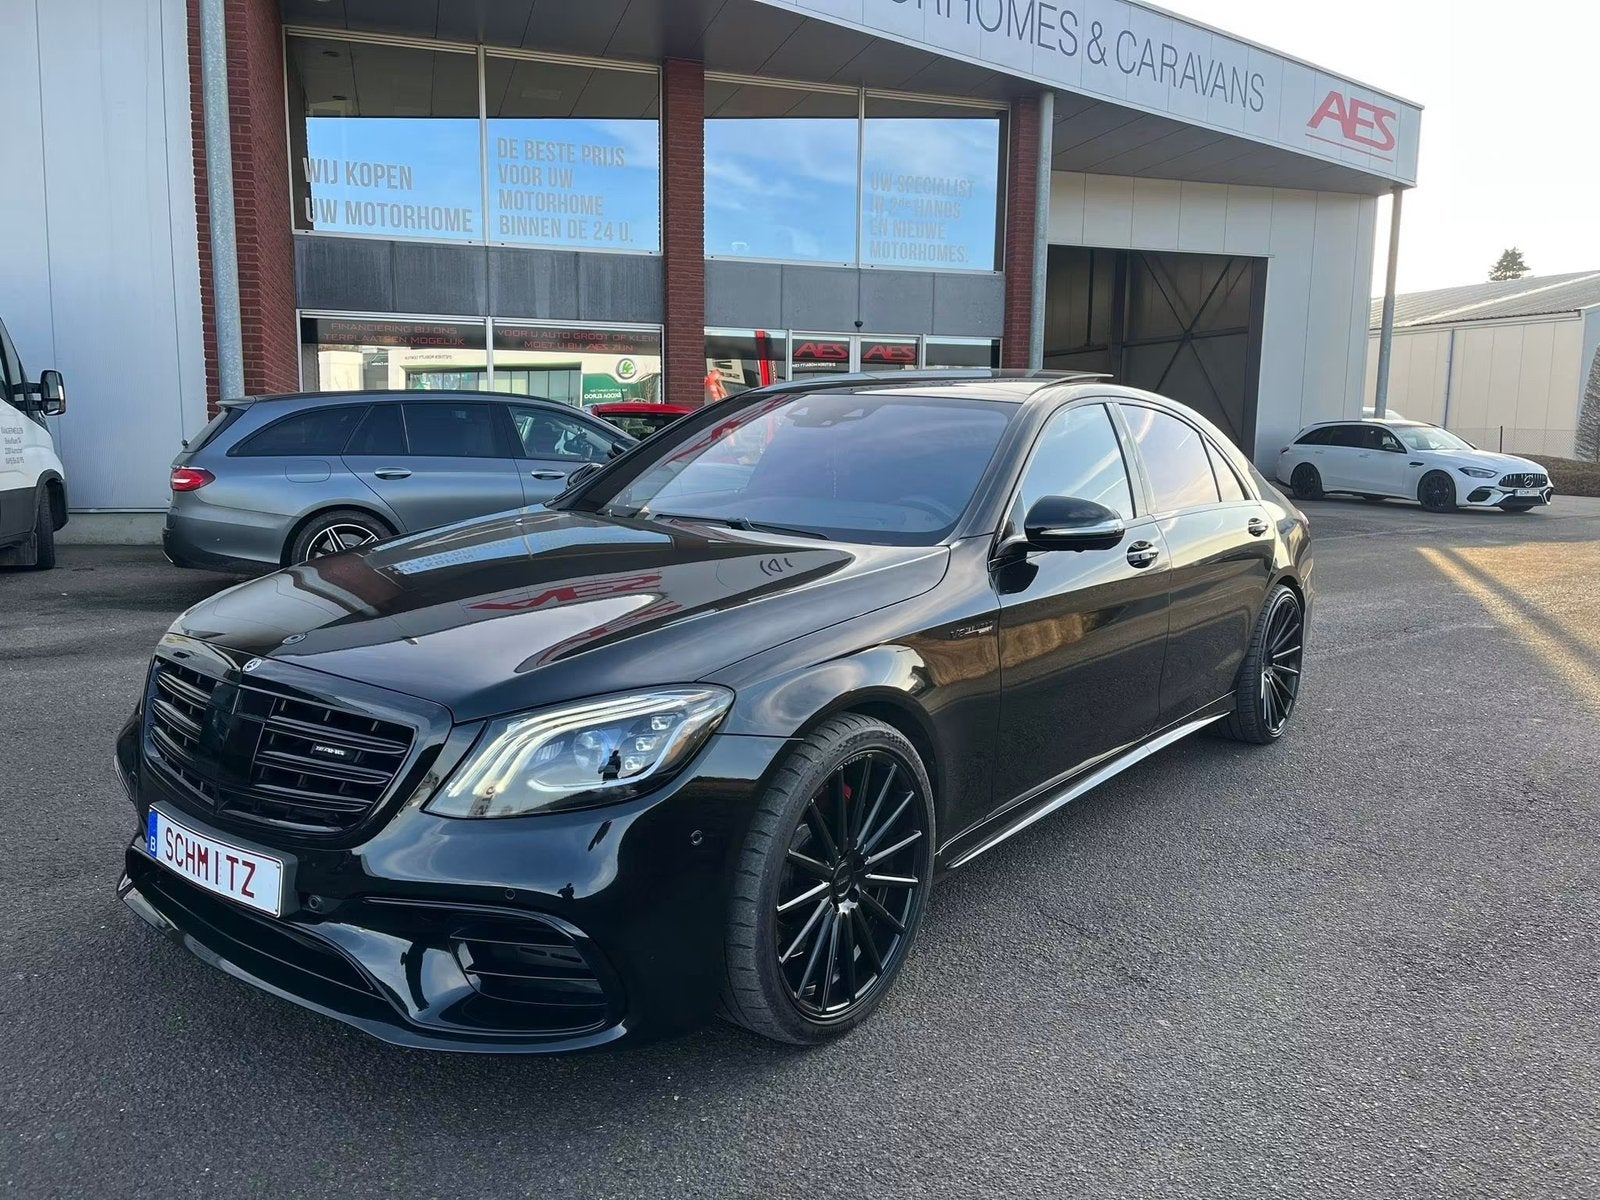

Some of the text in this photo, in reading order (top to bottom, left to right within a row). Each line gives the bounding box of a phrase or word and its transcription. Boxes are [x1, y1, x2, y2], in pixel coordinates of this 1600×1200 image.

[892, 0, 1265, 113] OMES & CARAVANS
[1306, 90, 1397, 152] AES
[497, 137, 626, 168] DE BESTE PRIJS
[303, 157, 413, 190] WIJ KOPEN
[498, 164, 575, 189] VOOR UW
[871, 171, 976, 199] UW SPECIALIST
[305, 197, 473, 233] UW MOTORHOME
[499, 188, 604, 216] MOTORHOME
[915, 199, 961, 219] HANDS
[499, 214, 563, 238] BINNEN
[567, 218, 588, 240] DE
[593, 220, 617, 242] 24
[871, 218, 946, 241] EN NIEUWE
[331, 322, 412, 334] FINANCIERING
[497, 329, 528, 338] VOOR
[542, 331, 570, 340] AUTO
[573, 332, 609, 341] GROOT
[629, 334, 659, 343] KLEIN
[523, 341, 554, 350] MOET
[794, 342, 849, 359] AES
[863, 344, 917, 361] AES
[150, 836, 156, 852] B
[165, 826, 256, 899] SCHMITZ
